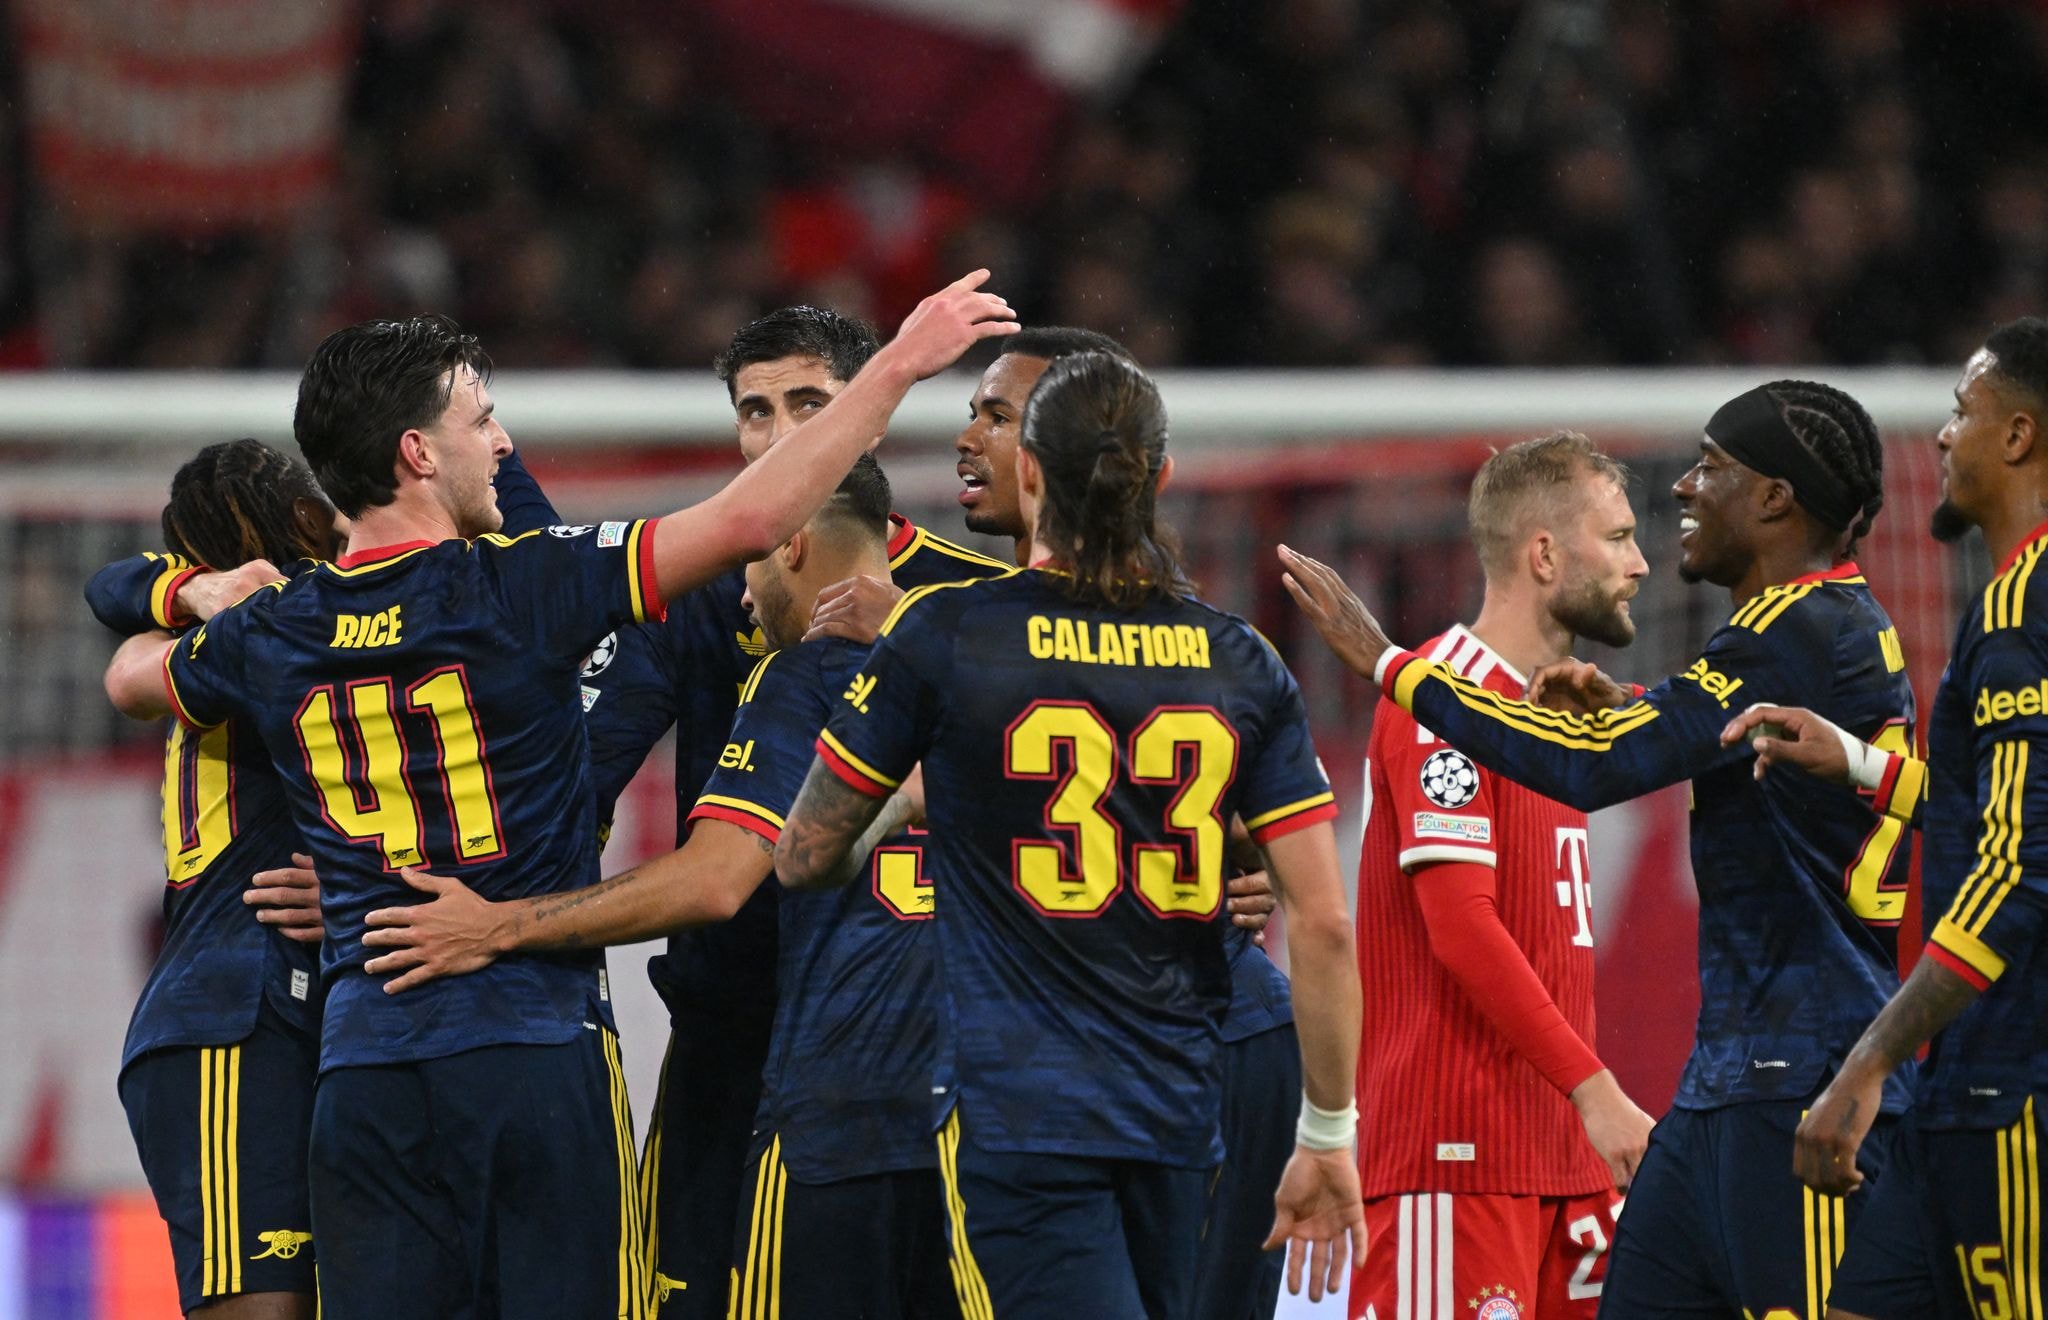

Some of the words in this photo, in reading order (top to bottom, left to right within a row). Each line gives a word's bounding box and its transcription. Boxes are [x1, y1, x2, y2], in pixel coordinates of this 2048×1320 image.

[329, 604, 402, 648] RICE
[1027, 615, 1211, 669] CALAFIORI
[293, 663, 507, 873] 41
[1004, 698, 1240, 922] 33
[1416, 820, 1489, 834] FOUNDATION
